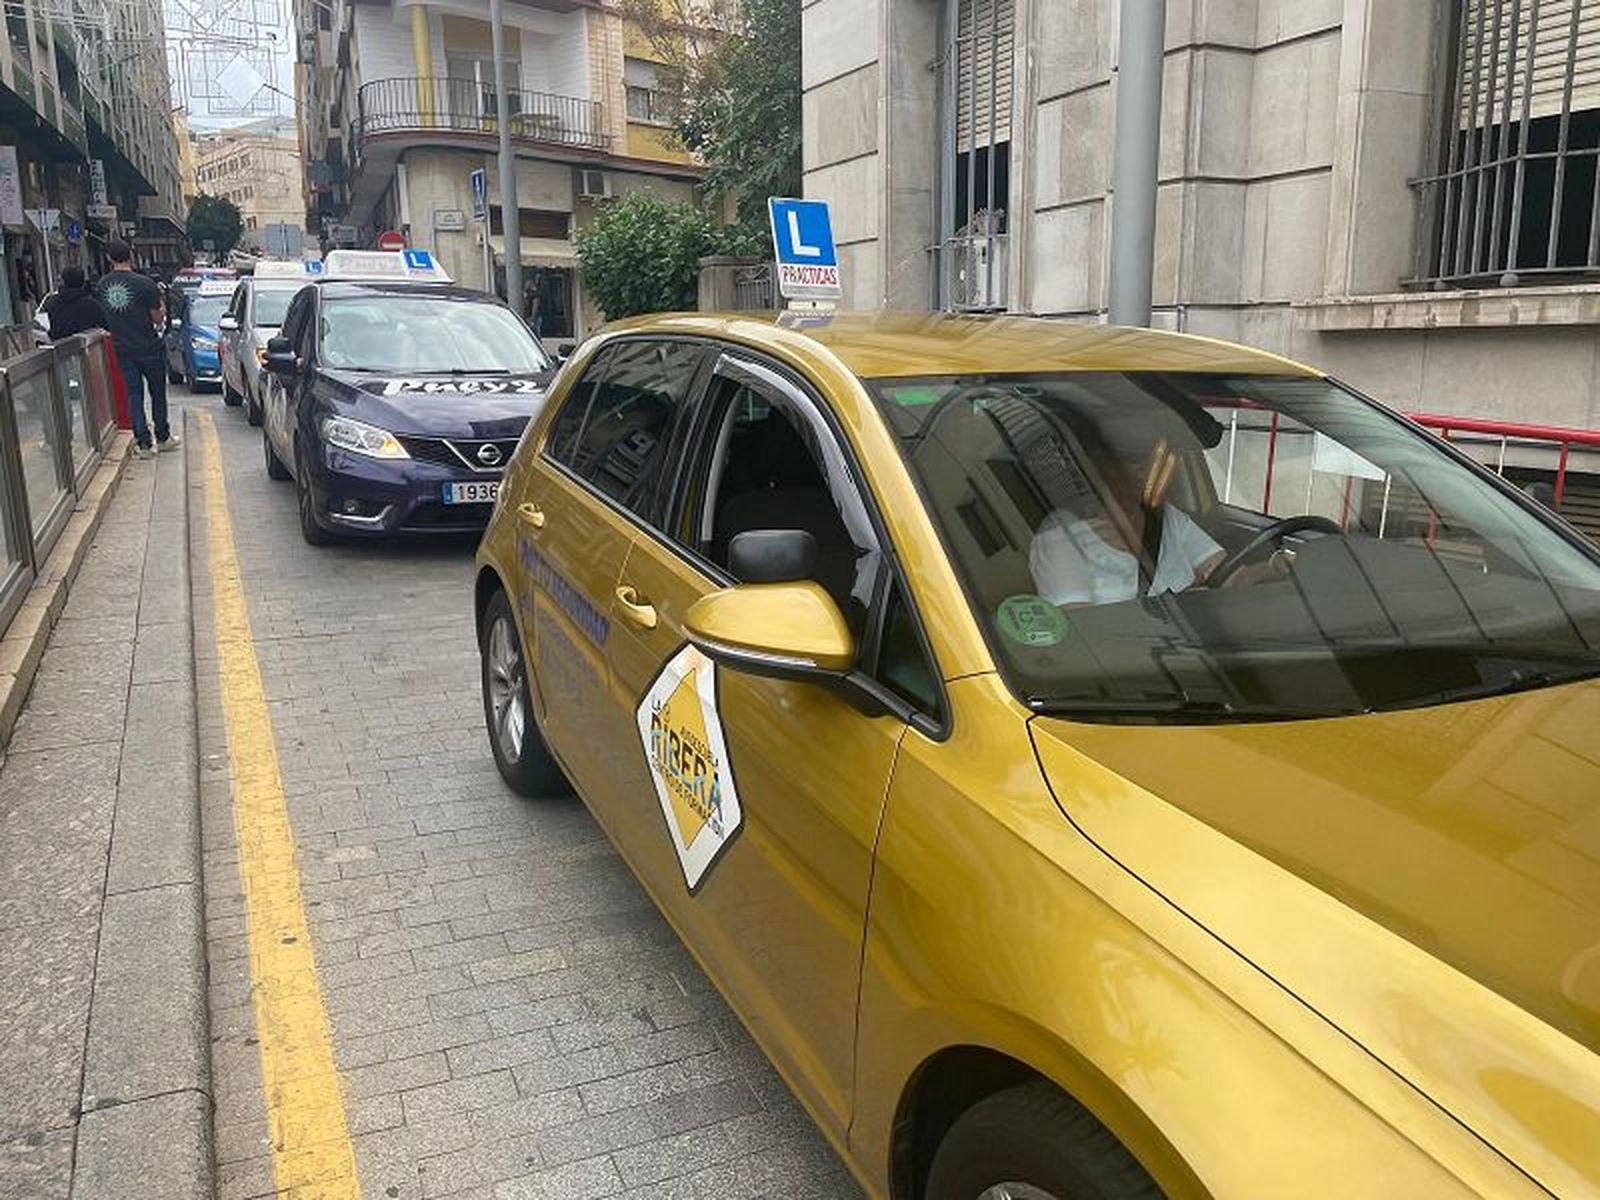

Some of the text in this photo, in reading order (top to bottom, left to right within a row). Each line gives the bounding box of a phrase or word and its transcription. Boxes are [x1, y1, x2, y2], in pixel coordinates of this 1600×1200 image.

[787, 210, 821, 257] L
[409, 252, 427, 267] L
[457, 483, 498, 501] 1936
[651, 711, 724, 823] RIBERA
